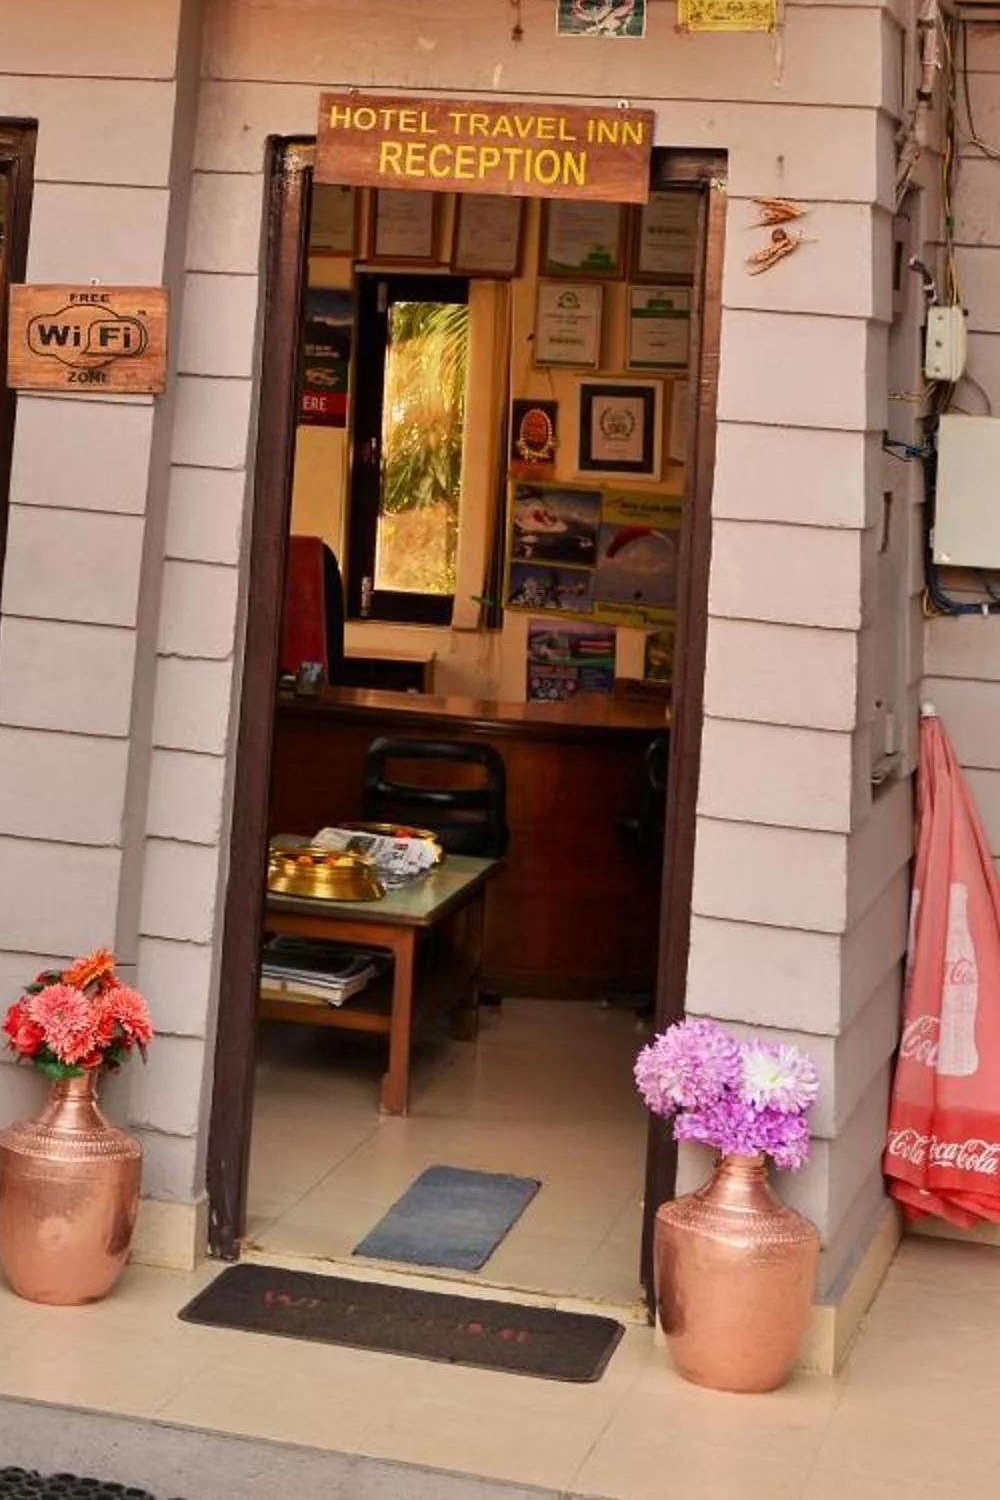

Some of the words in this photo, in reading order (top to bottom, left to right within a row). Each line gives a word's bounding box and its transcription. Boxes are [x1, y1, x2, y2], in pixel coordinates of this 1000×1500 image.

[330, 105, 438, 135] HOTEL
[449, 112, 577, 142] TRAVEL
[587, 118, 645, 146] INN
[378, 140, 587, 186] RECEPTION
[69, 292, 110, 303] FREE
